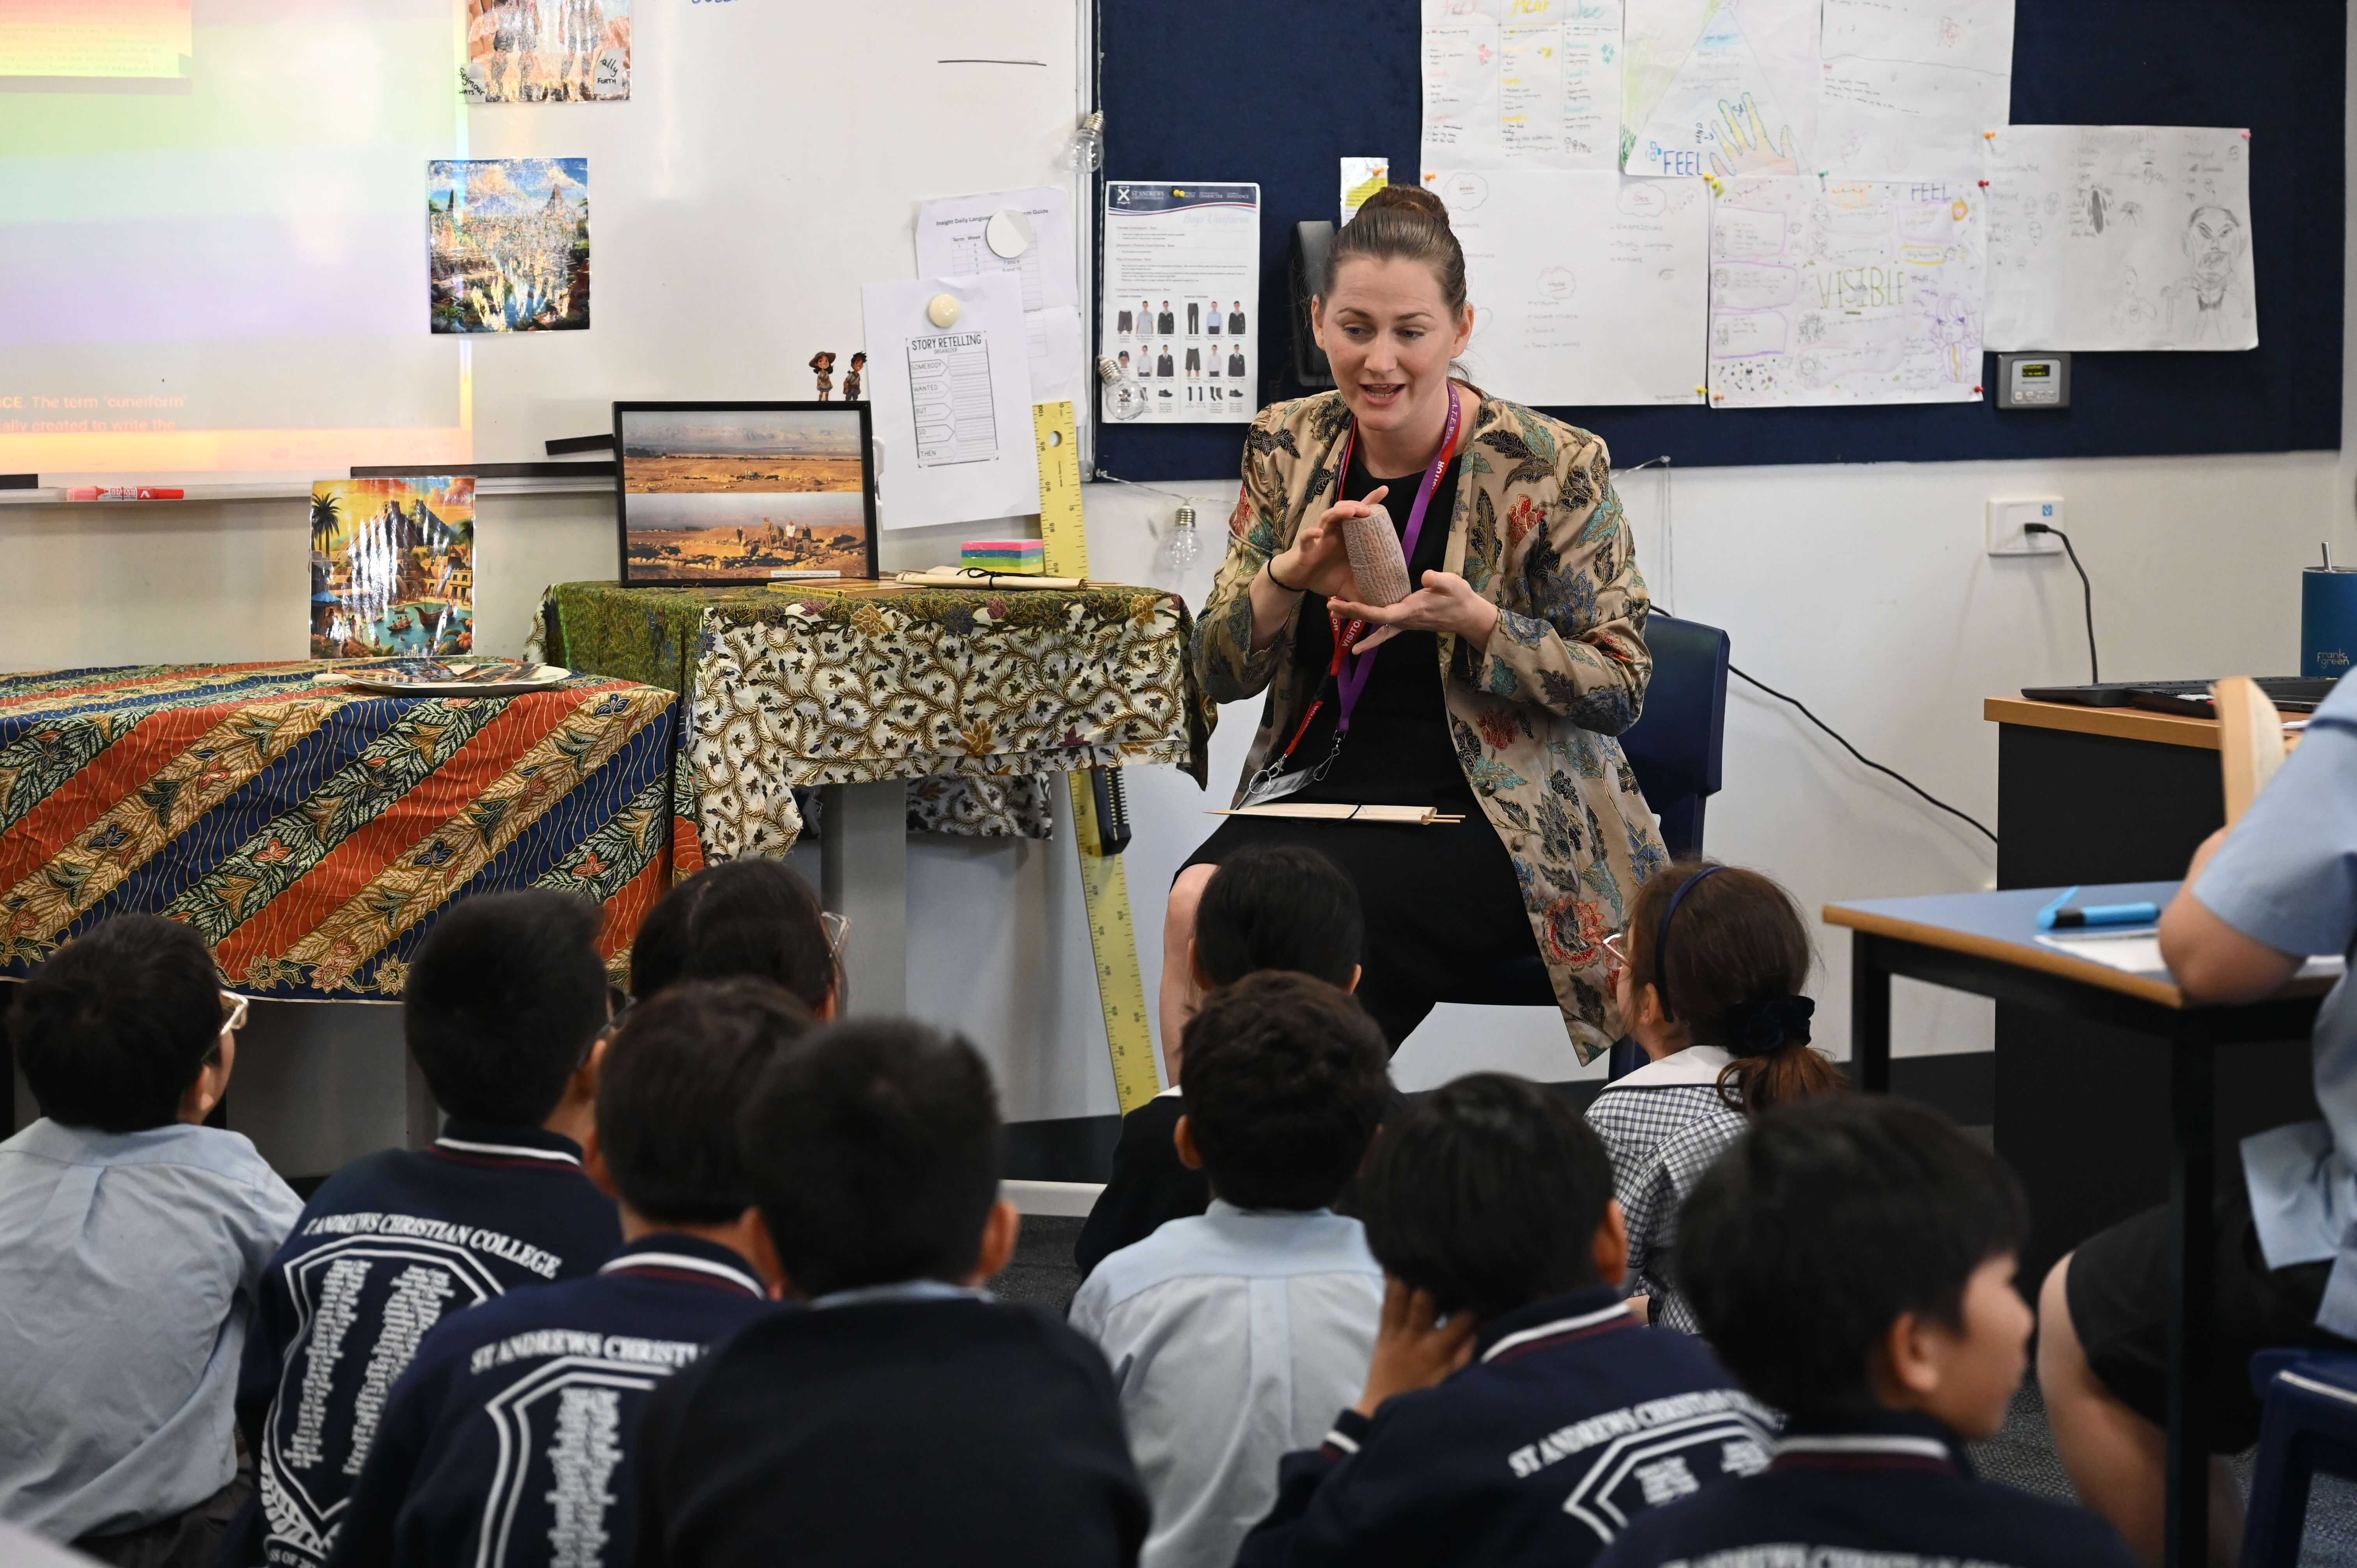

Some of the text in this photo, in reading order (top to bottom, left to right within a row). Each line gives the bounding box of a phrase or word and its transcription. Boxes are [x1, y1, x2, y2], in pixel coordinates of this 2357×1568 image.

[599, 57, 618, 77] ally
[459, 67, 486, 96] Seymour
[1664, 150, 1703, 175] FEEL
[1816, 267, 1904, 309] VISIBLE
[912, 334, 982, 351] STORY RETELLING
[32, 395, 60, 408] The
[63, 396, 98, 408] term
[32, 420, 87, 431] created
[93, 419, 107, 431] to
[112, 420, 147, 431] write
[152, 418, 176, 431] the
[2317, 648, 2346, 662] frank
[2321, 657, 2349, 669] green
[378, 1213, 474, 1245] CHRISTIAN
[469, 1229, 563, 1280] COLLEGE
[470, 1328, 699, 1374] ST ANDREWS CHRIST
[1508, 1444, 1541, 1478] ST
